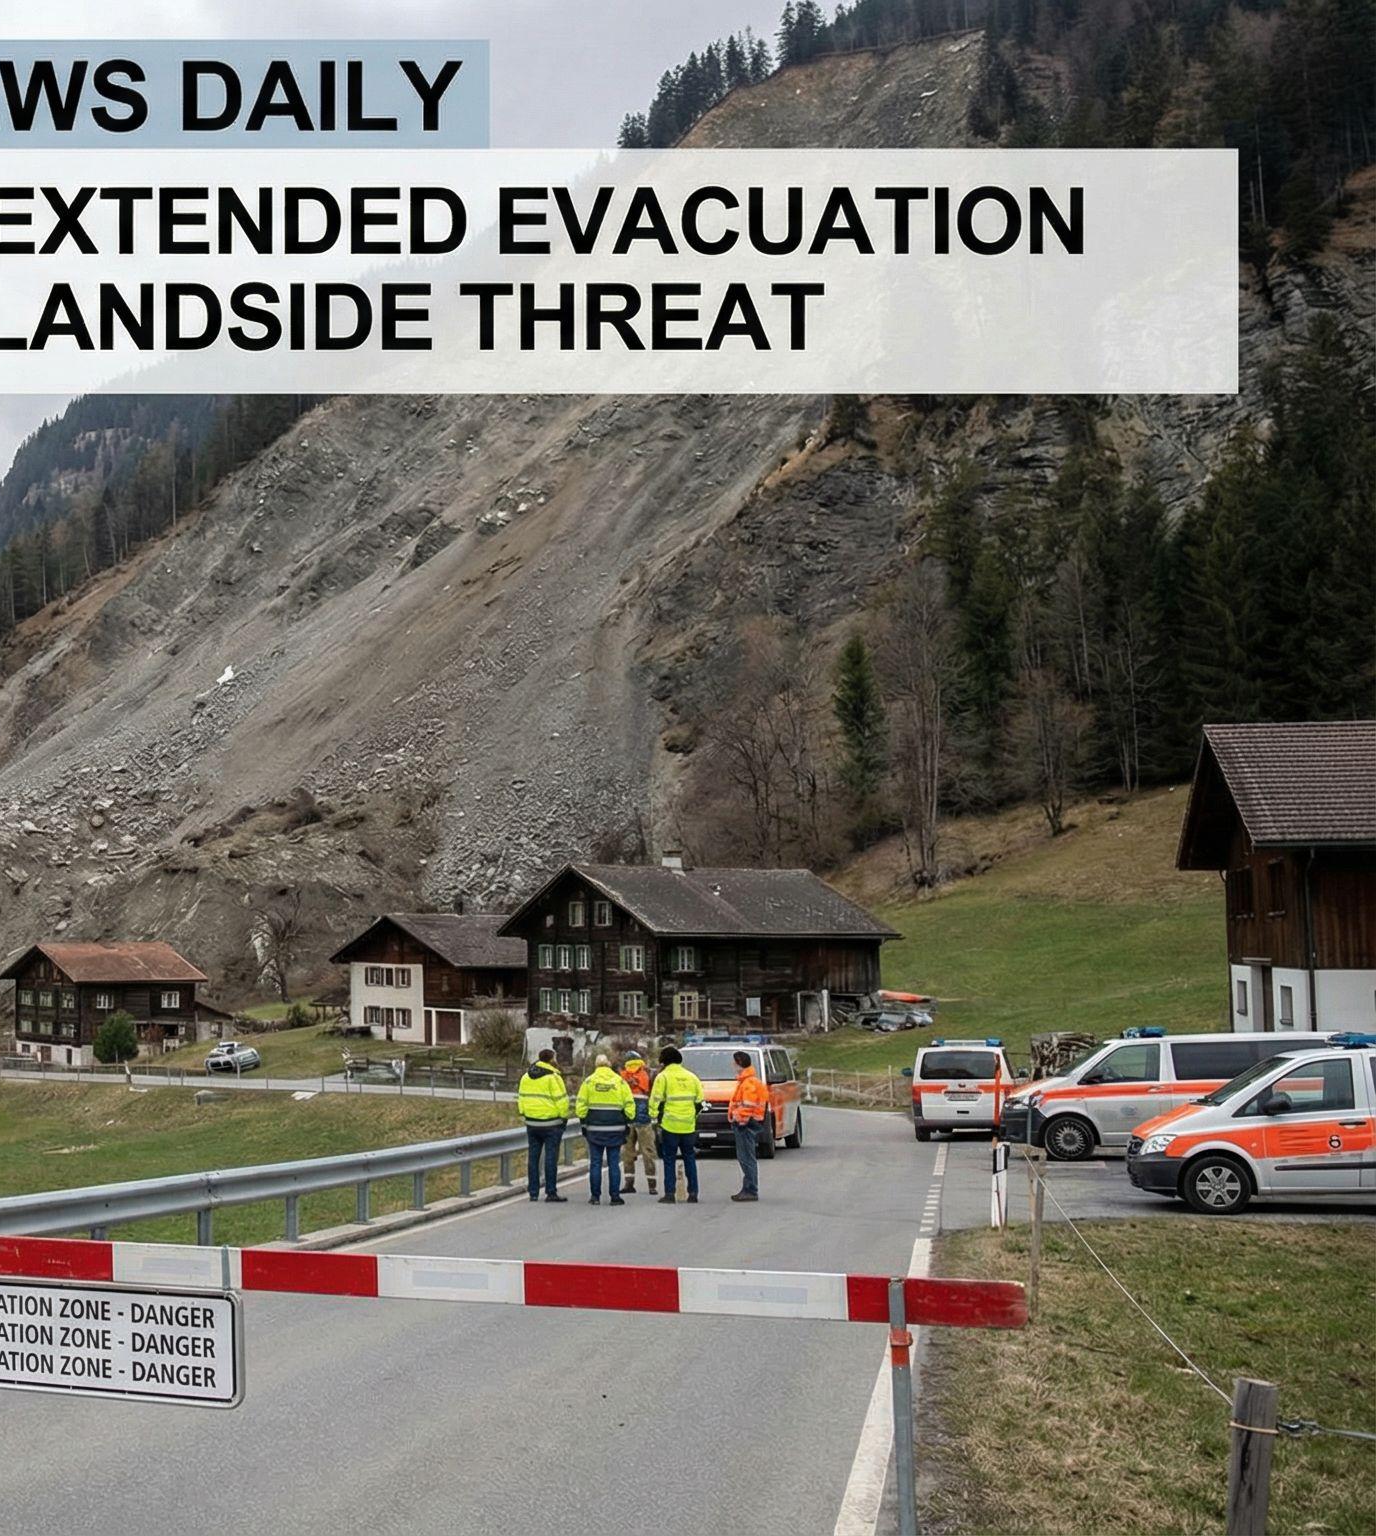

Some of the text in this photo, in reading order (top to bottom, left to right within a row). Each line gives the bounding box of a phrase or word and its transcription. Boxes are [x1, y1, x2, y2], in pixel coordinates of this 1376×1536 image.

[59, 1297, 111, 1322] ZONE
[130, 1302, 215, 1329] DANGER
[59, 1326, 112, 1350] ZONE
[131, 1332, 216, 1359] DANGER
[60, 1355, 112, 1379] ZONE
[132, 1361, 216, 1388] DANGER
